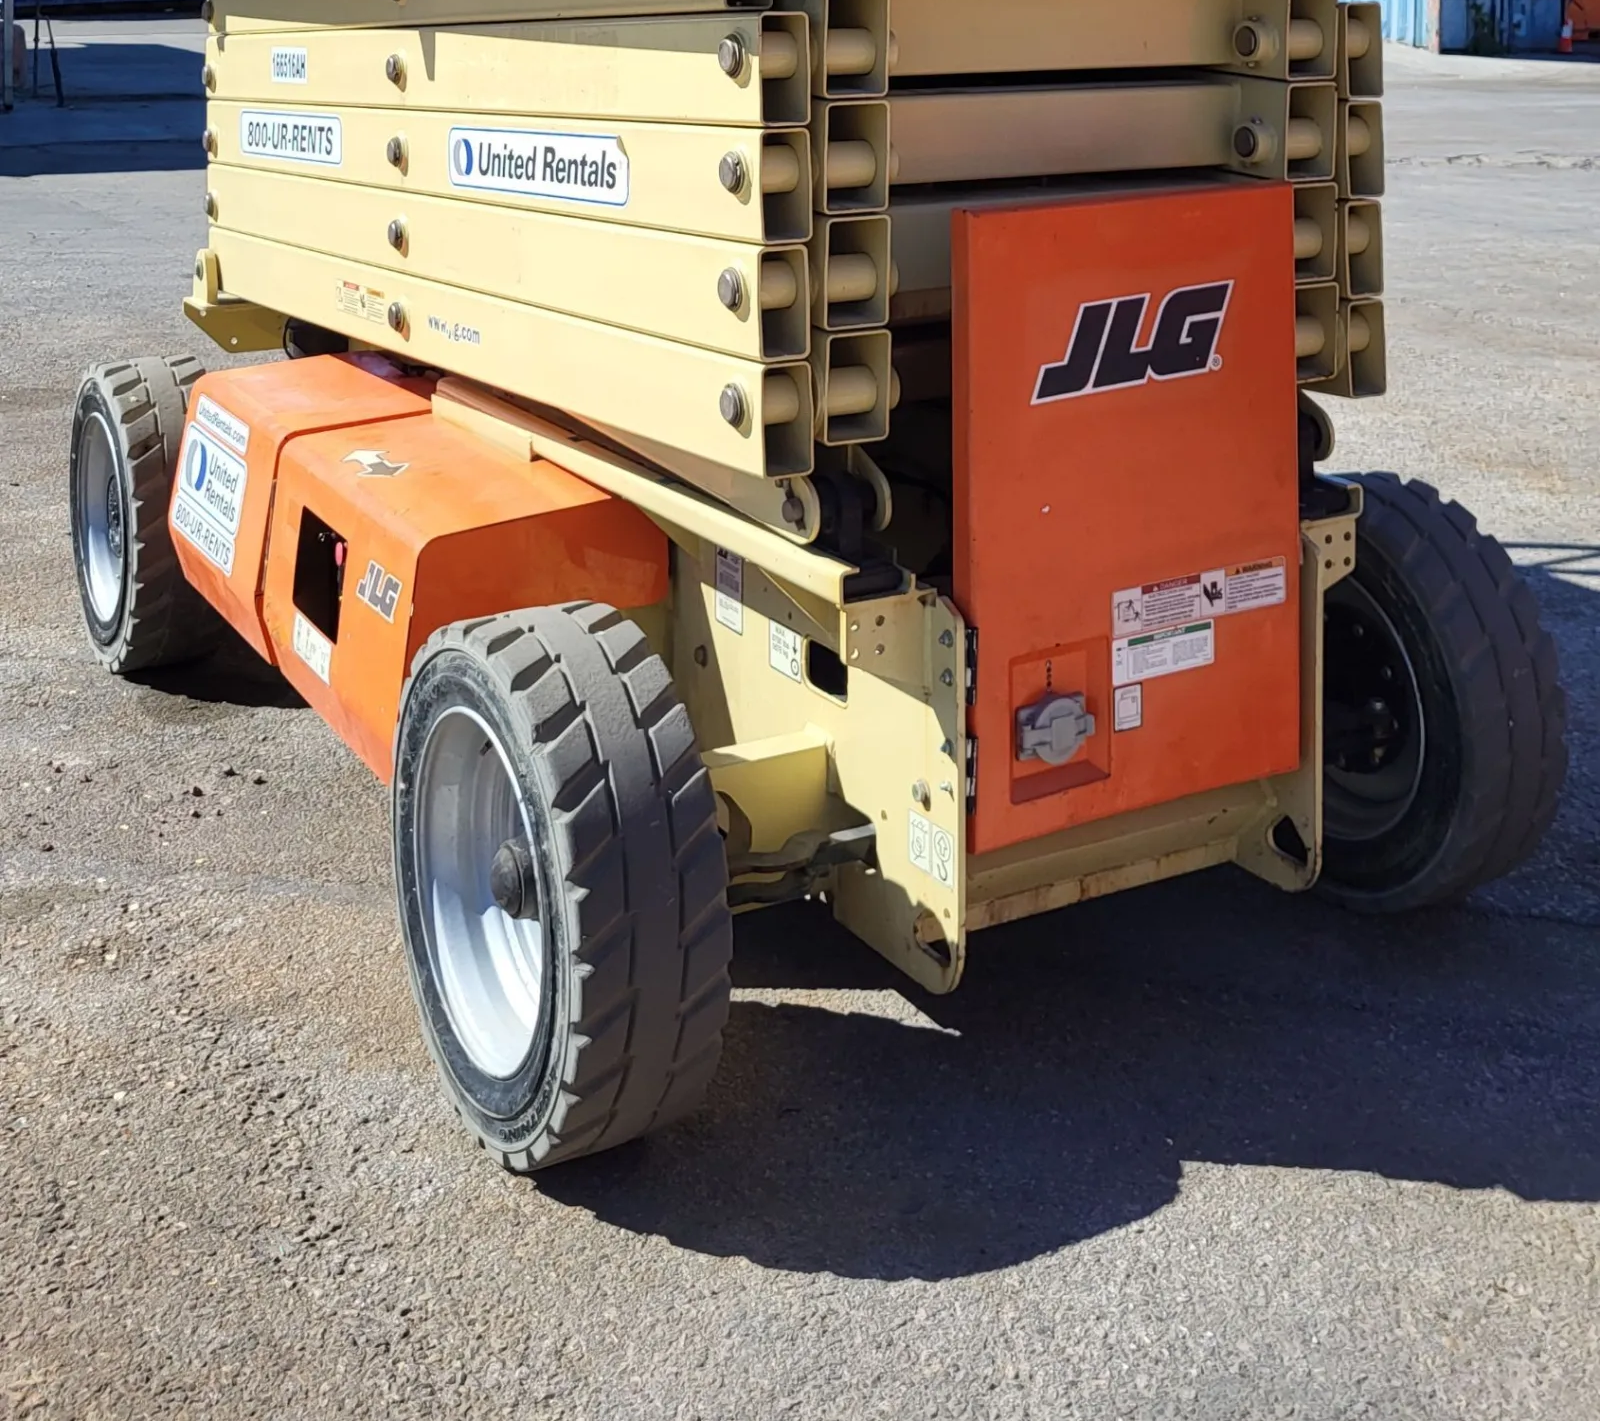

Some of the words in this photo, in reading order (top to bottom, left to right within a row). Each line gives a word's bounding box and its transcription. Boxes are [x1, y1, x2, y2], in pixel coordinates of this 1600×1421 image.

[271, 51, 307, 80] 166516AH
[247, 121, 334, 156] 800-UR-RENTS
[478, 142, 536, 182] United
[542, 145, 617, 190] Rentals
[1030, 279, 1235, 406] JLG
[209, 453, 240, 494] United
[204, 479, 236, 523] Rentals
[175, 503, 231, 566] 800-UR-RENTS
[356, 559, 403, 625] JLG
[1159, 578, 1188, 591] DANGER
